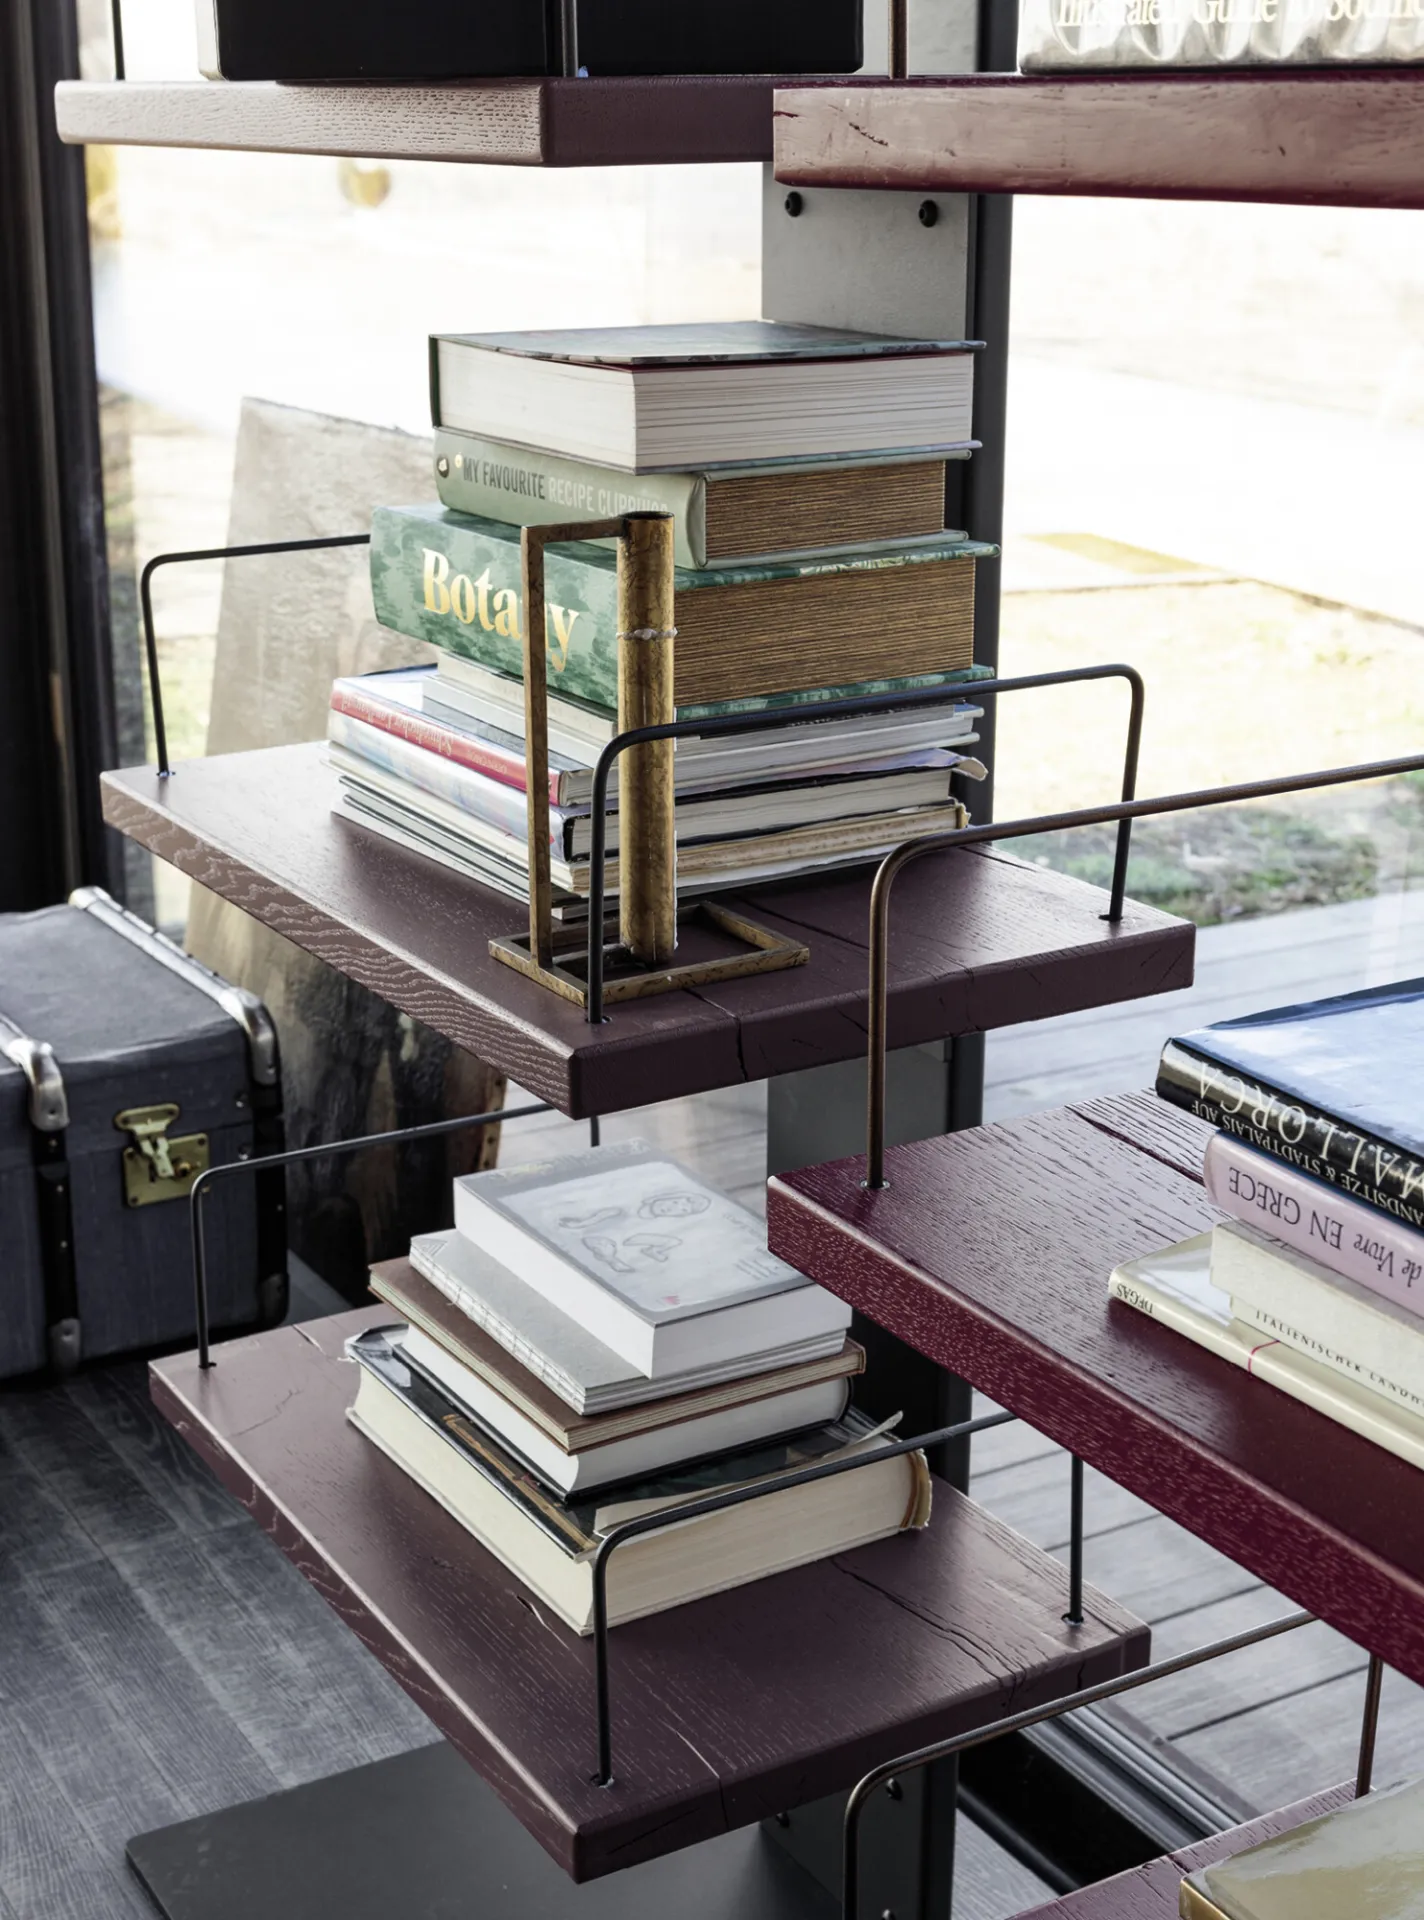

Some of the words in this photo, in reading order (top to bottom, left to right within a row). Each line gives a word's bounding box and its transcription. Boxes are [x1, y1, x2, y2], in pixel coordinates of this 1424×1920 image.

[463, 457, 479, 483] MY
[483, 462, 545, 500] FAVOURITE
[549, 477, 594, 513] RECIPE
[598, 488, 668, 517] CLIPP
[422, 548, 580, 673] Botay
[1191, 1100, 1220, 1123] AUF
[1199, 1061, 1424, 1204] MALLORCA
[1222, 1112, 1321, 1176] STADTPALAIS
[1228, 1165, 1301, 1225] GRECE
[1325, 1165, 1336, 1182] &
[1308, 1209, 1345, 1251] EN
[1353, 1232, 1395, 1278] Vivre
[1401, 1258, 1423, 1288] de
[1116, 1283, 1154, 1314] DEGAS
